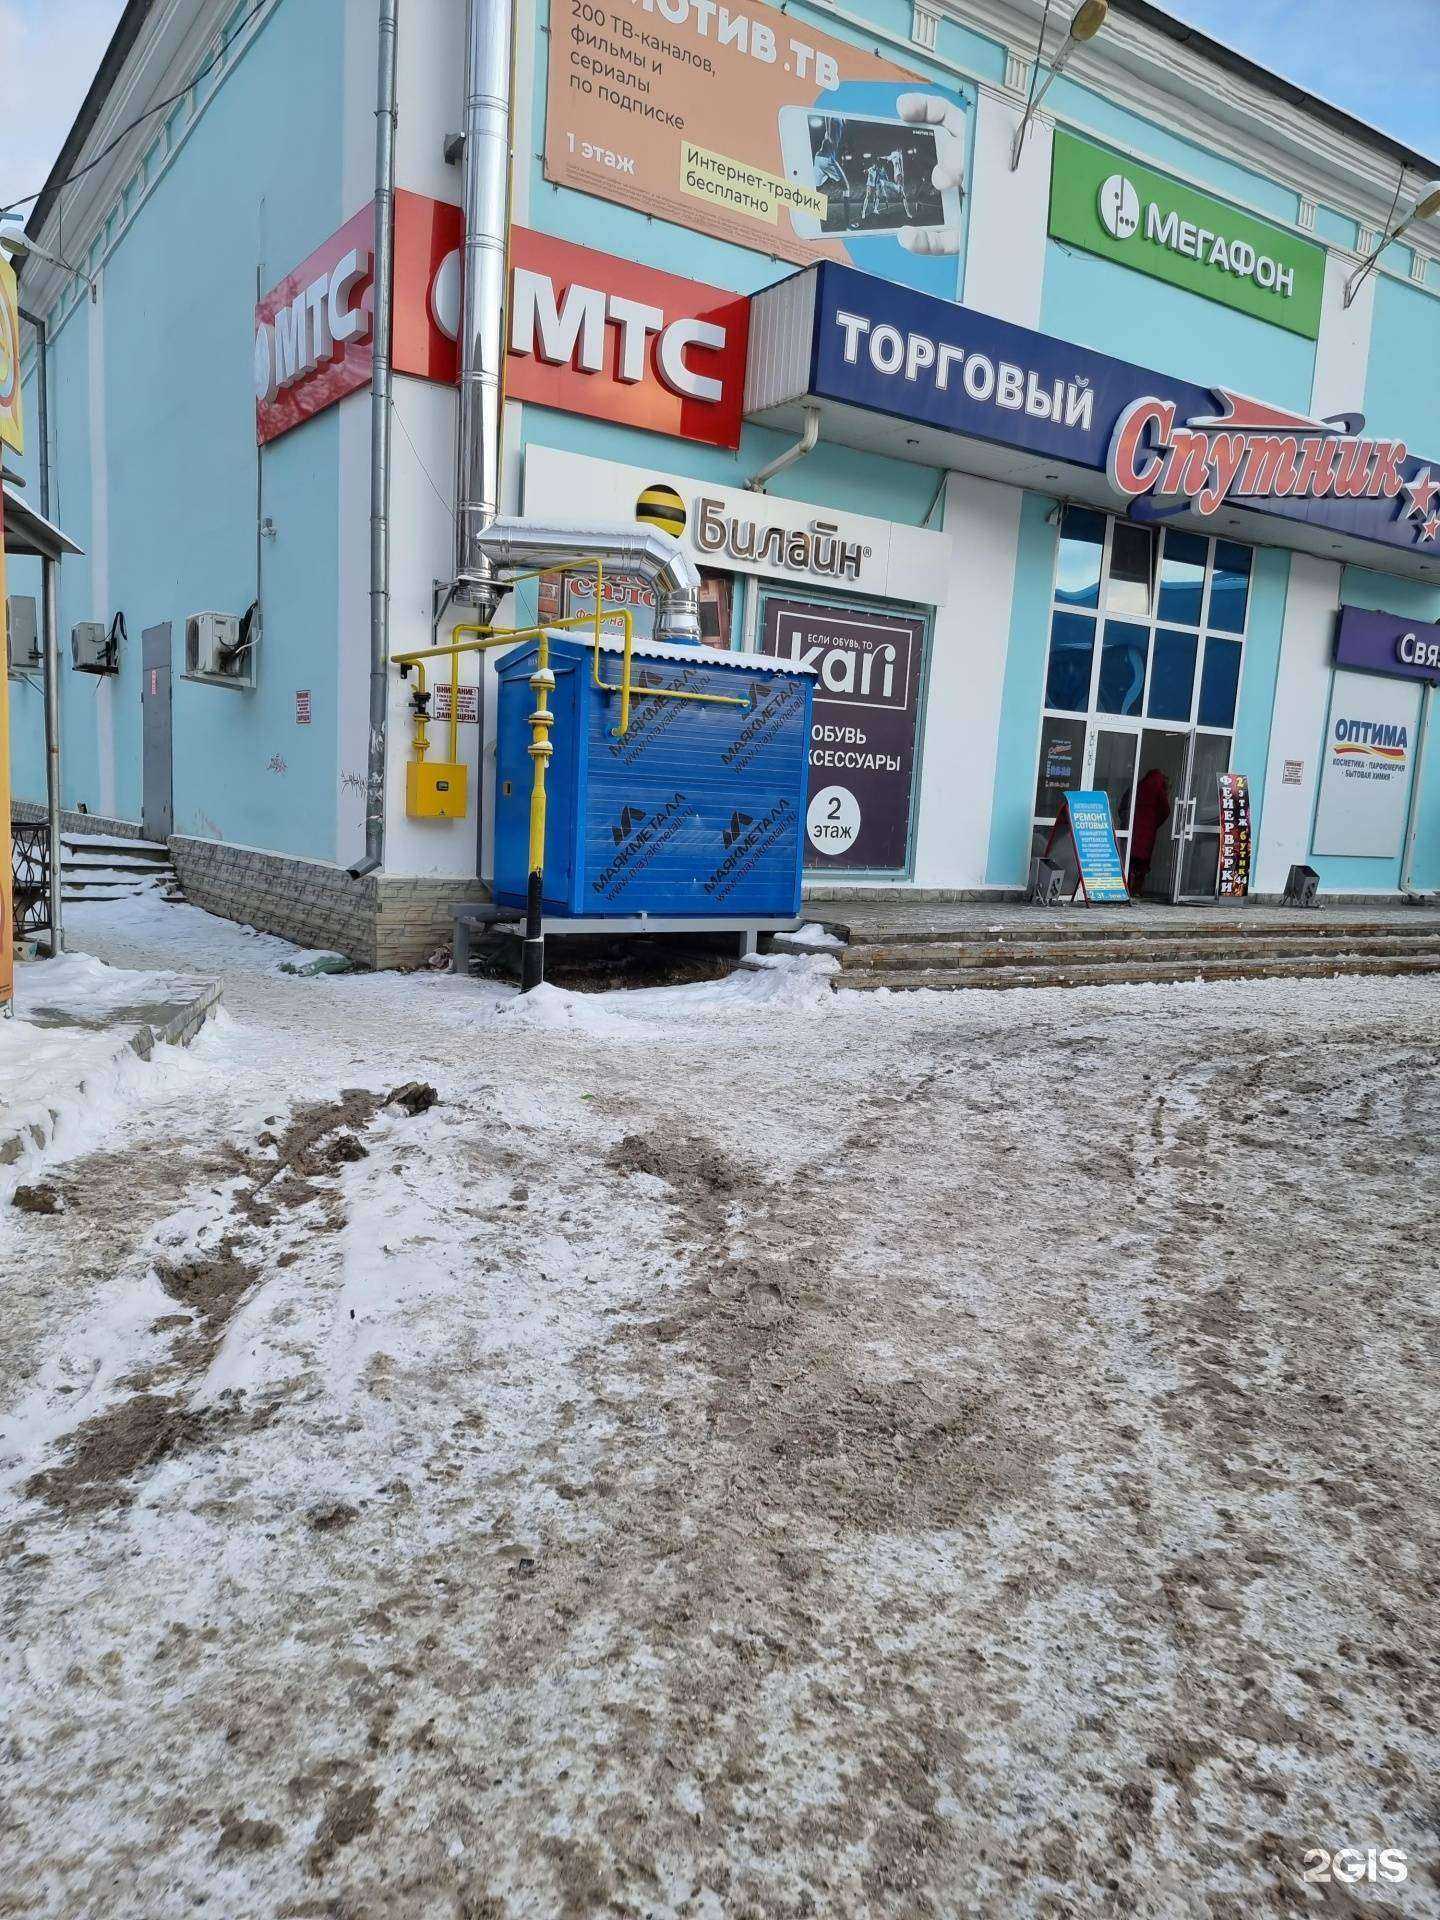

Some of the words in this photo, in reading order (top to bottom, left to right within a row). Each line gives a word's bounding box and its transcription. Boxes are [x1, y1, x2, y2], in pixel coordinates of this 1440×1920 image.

[570, 24, 646, 69] фильмы
[651, 59, 663, 76] и
[571, 0, 606, 28] 200
[610, 14, 717, 78] ТВ-каналов,
[570, 50, 651, 94] сериалы
[570, 74, 593, 94] по
[598, 85, 686, 131] подписке
[566, 131, 576, 153] 1
[581, 141, 636, 177] этаж
[685, 170, 769, 214] бесплатно
[686, 147, 822, 213] Интернет-трафик
[274, 248, 370, 387] МТС
[509, 266, 727, 404] МТС
[835, 309, 1095, 432] ТОРГОВЫЙ
[1106, 394, 1408, 517] Спутник
[807, 633, 830, 645] ЕСЛИ
[862, 641, 873, 650] ТО
[1400, 632, 1440, 668] Свя
[789, 631, 897, 698] kari
[811, 723, 868, 745] ОБУВЬ
[1334, 718, 1408, 748] ОПТИМА
[1235, 777, 1245, 787] 2
[1332, 758, 1365, 769] КОСМЕТИКА
[813, 822, 853, 840] этаж
[827, 797, 842, 820] 2
[1073, 812, 1107, 822] РЕМОНТ
[1219, 775, 1235, 893] ФЕЙЕРВЕРКИ
